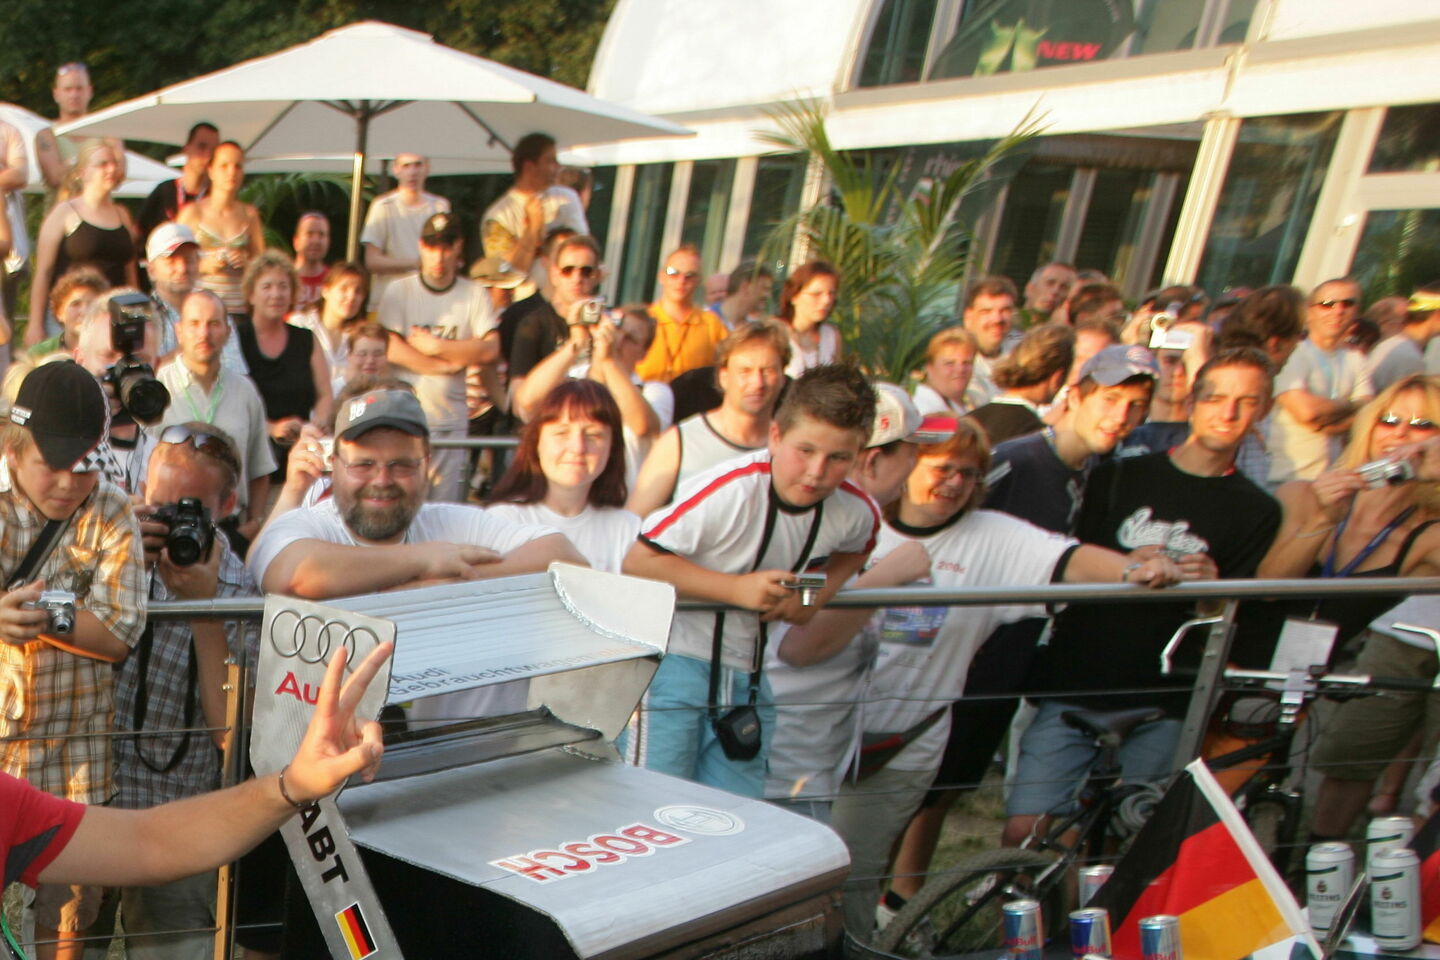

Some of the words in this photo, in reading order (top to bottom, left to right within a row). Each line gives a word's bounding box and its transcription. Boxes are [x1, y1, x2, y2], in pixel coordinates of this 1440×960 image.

[1036, 40, 1103, 61] NEW
[274, 671, 321, 705] Au
[300, 802, 350, 884] ABT
[496, 825, 683, 881] BOSCH
